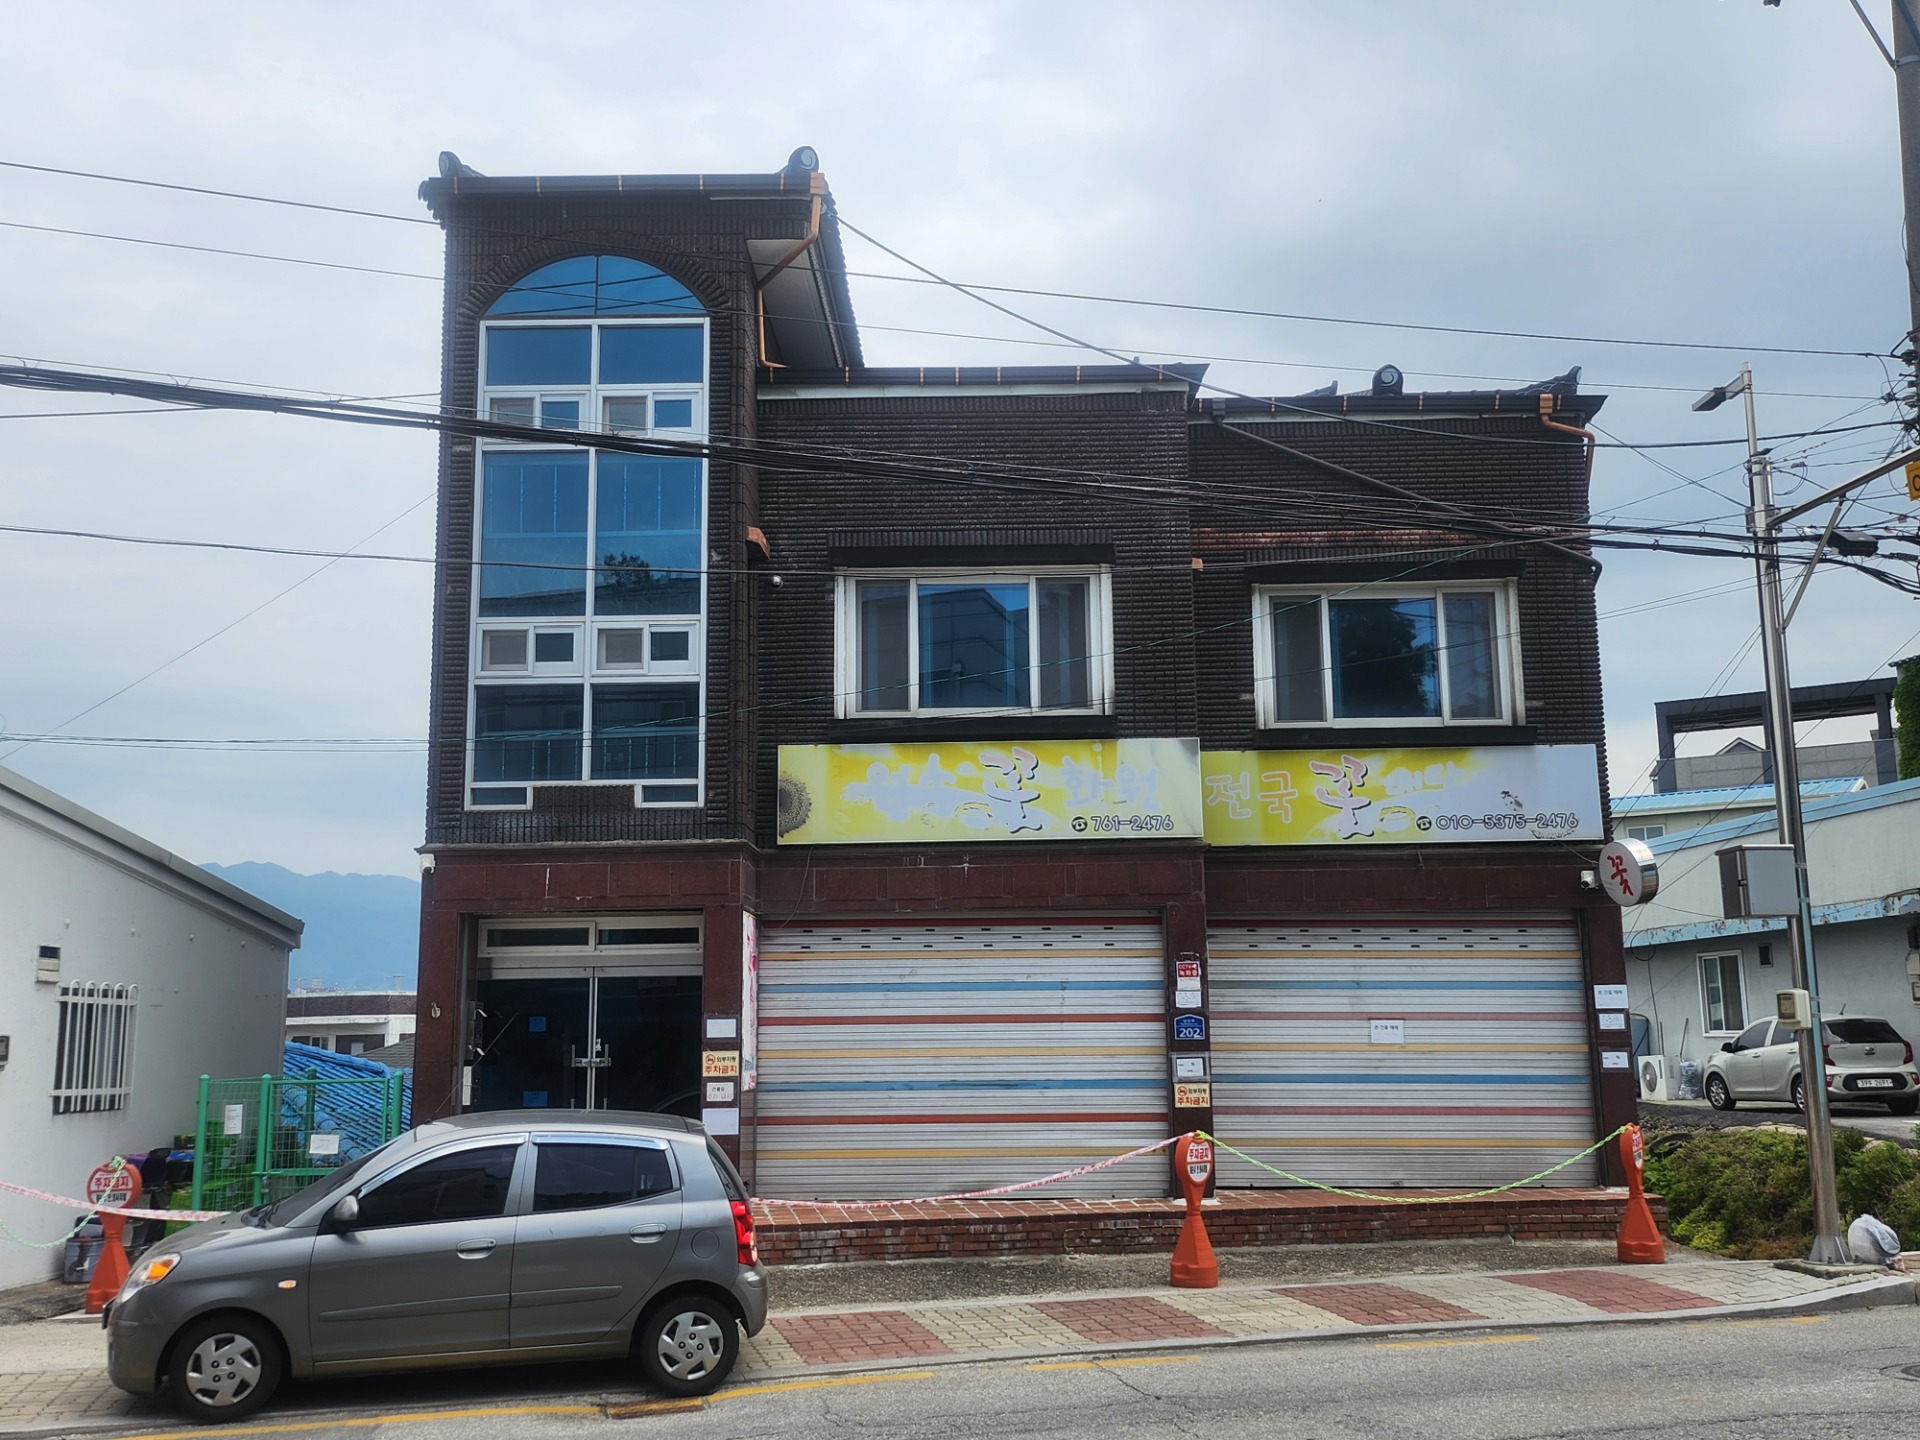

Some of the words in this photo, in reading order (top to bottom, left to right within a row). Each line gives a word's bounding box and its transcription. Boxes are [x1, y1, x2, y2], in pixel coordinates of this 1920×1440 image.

[1205, 770, 1298, 824] 전국
[1309, 753, 1375, 840] 꽃
[1091, 814, 1174, 832] 761-2476
[1435, 812, 1579, 831] 010-5375-2476
[1607, 855, 1634, 897] 꽃
[1179, 1027, 1201, 1038] 202
[704, 1065, 737, 1075] 주차금지
[1177, 1096, 1209, 1106] 주차금지
[1188, 1147, 1209, 1160] 주차금지
